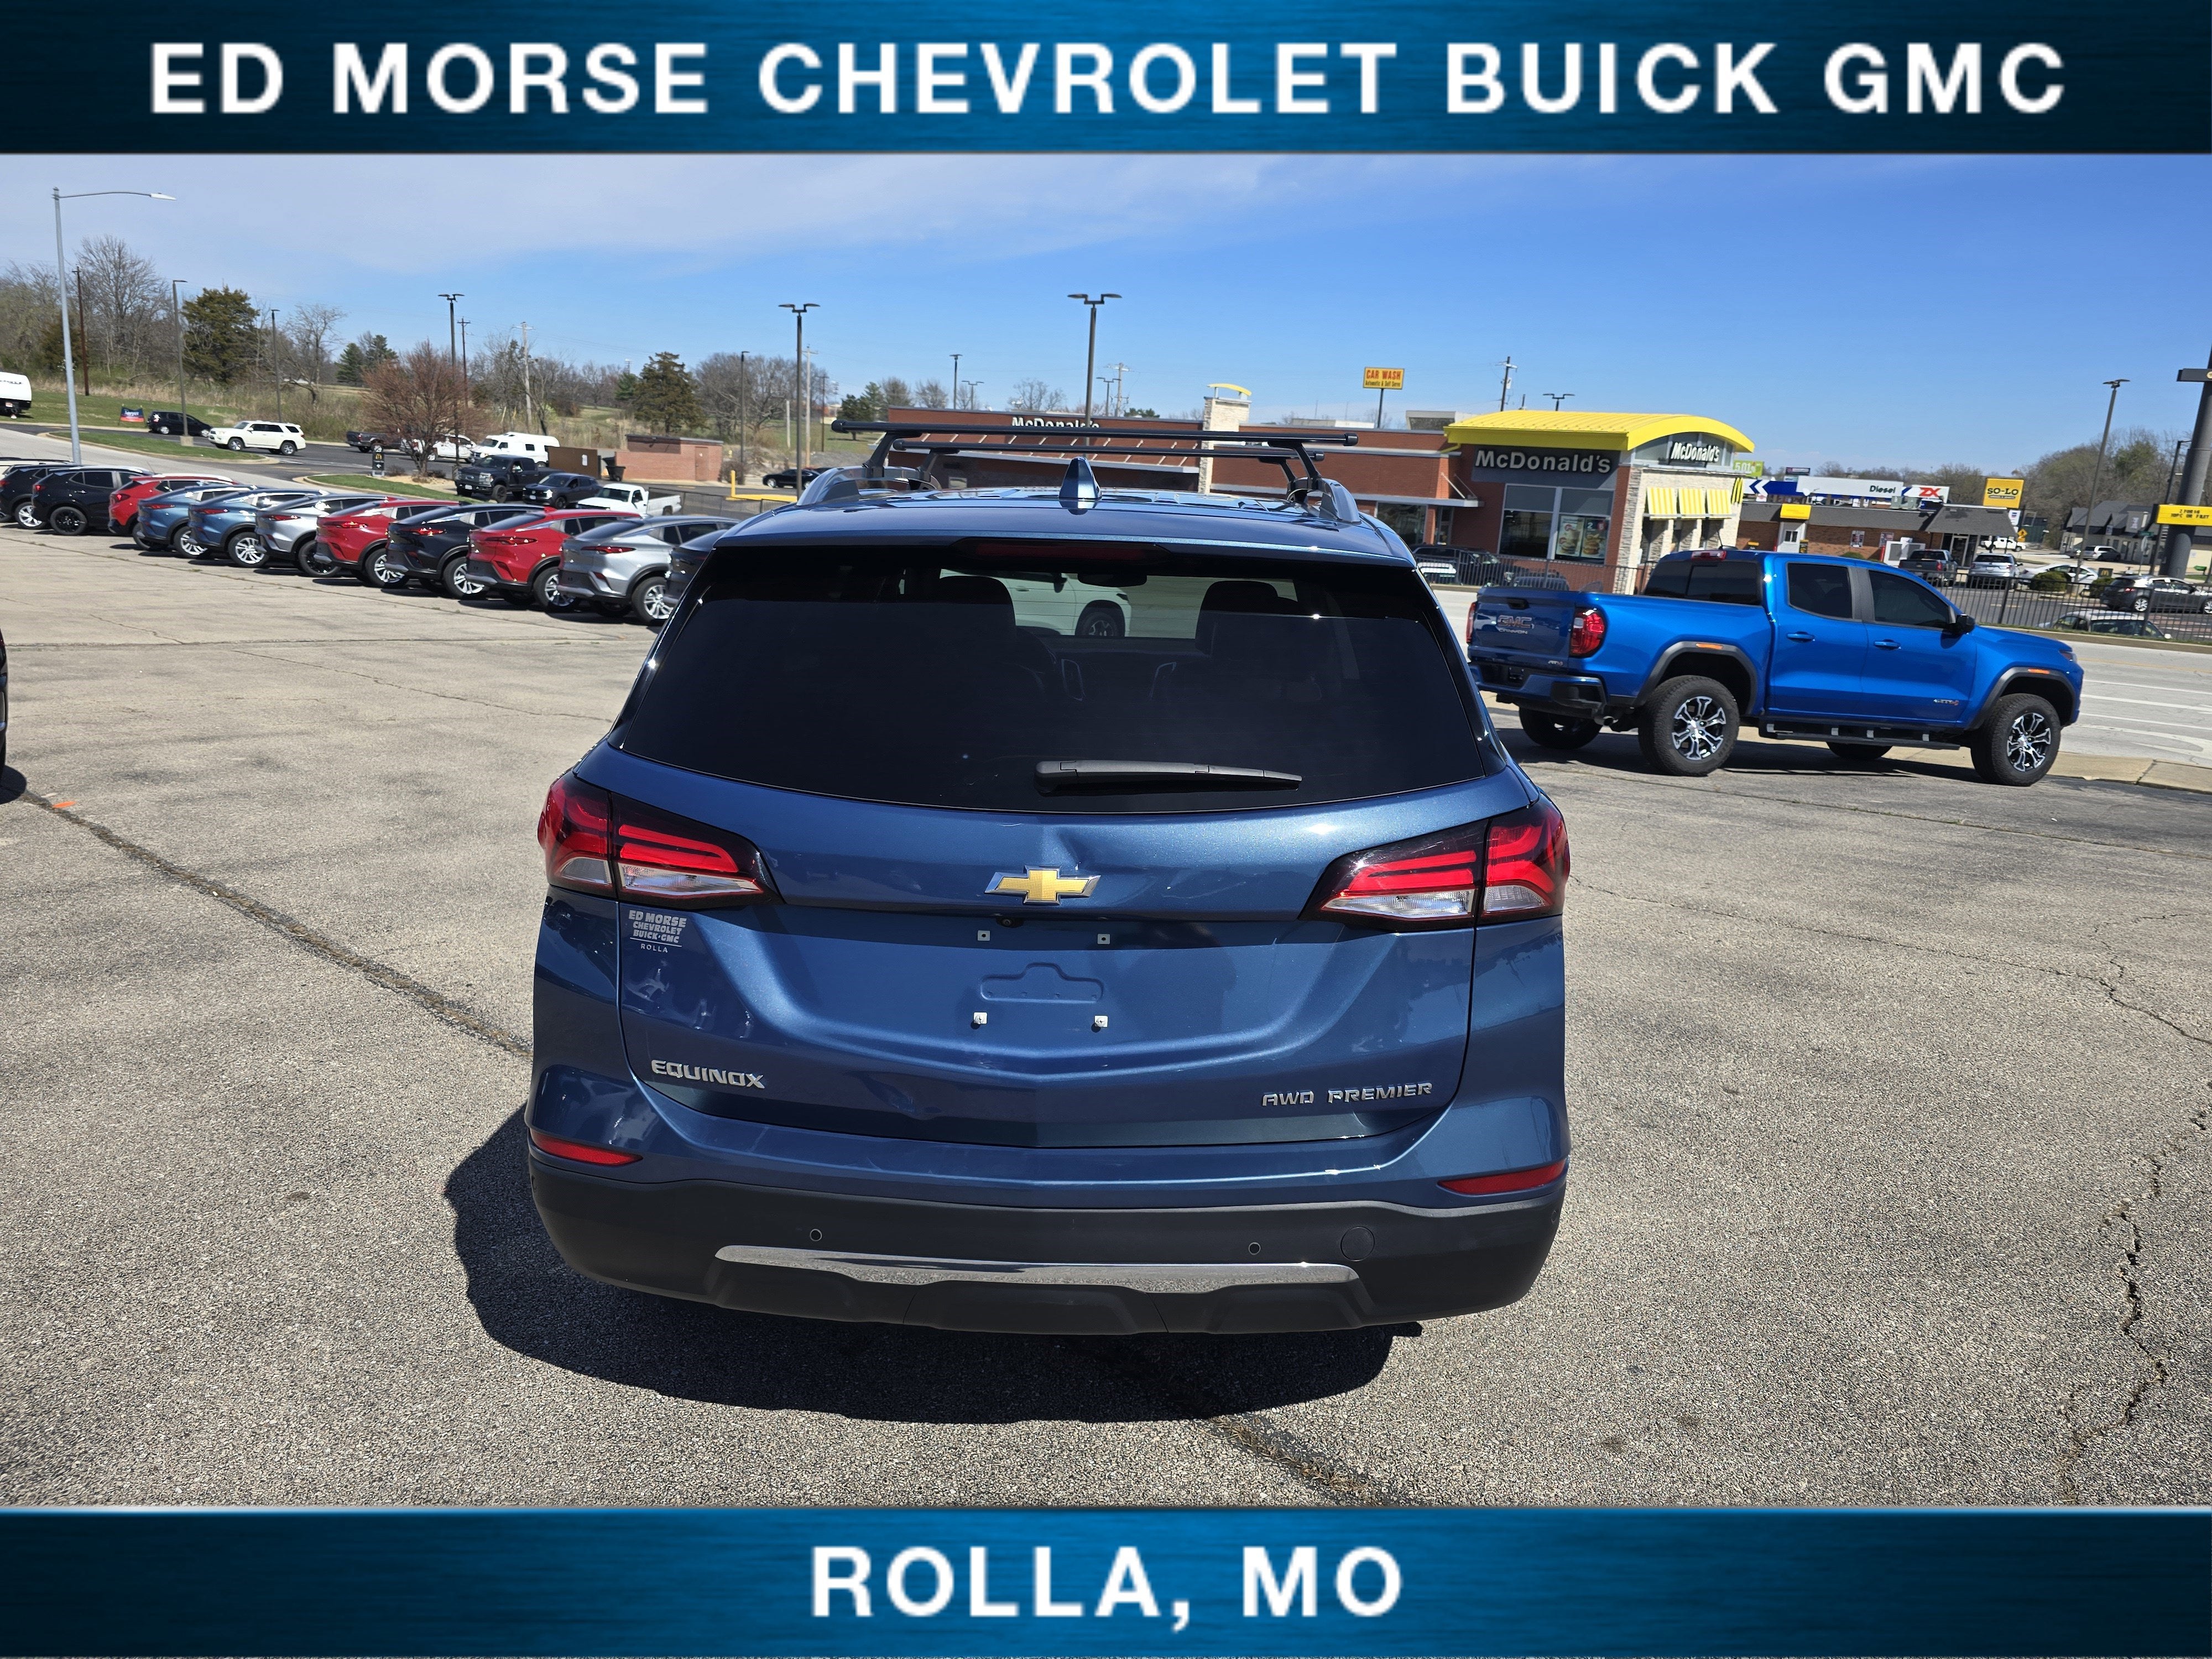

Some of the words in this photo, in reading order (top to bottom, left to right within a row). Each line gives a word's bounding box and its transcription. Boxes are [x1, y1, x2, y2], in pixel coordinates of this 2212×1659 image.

[1366, 369, 1379, 379] CAR
[1383, 371, 1402, 380] WASH
[1671, 442, 1720, 463] McDonald's
[1475, 450, 1611, 474] McDonald's
[1869, 485, 1896, 494] Diesel
[1919, 487, 1942, 497] ZX
[1498, 614, 1532, 628] GMC
[628, 910, 644, 921] ED
[645, 912, 687, 928] MORSE
[633, 921, 682, 935] CHEVROLET
[640, 943, 668, 953] ROLLA
[651, 1059, 765, 1089] EQUINOX
[1262, 1091, 1314, 1106] AWD
[1328, 1082, 1433, 1103] PREMIER
